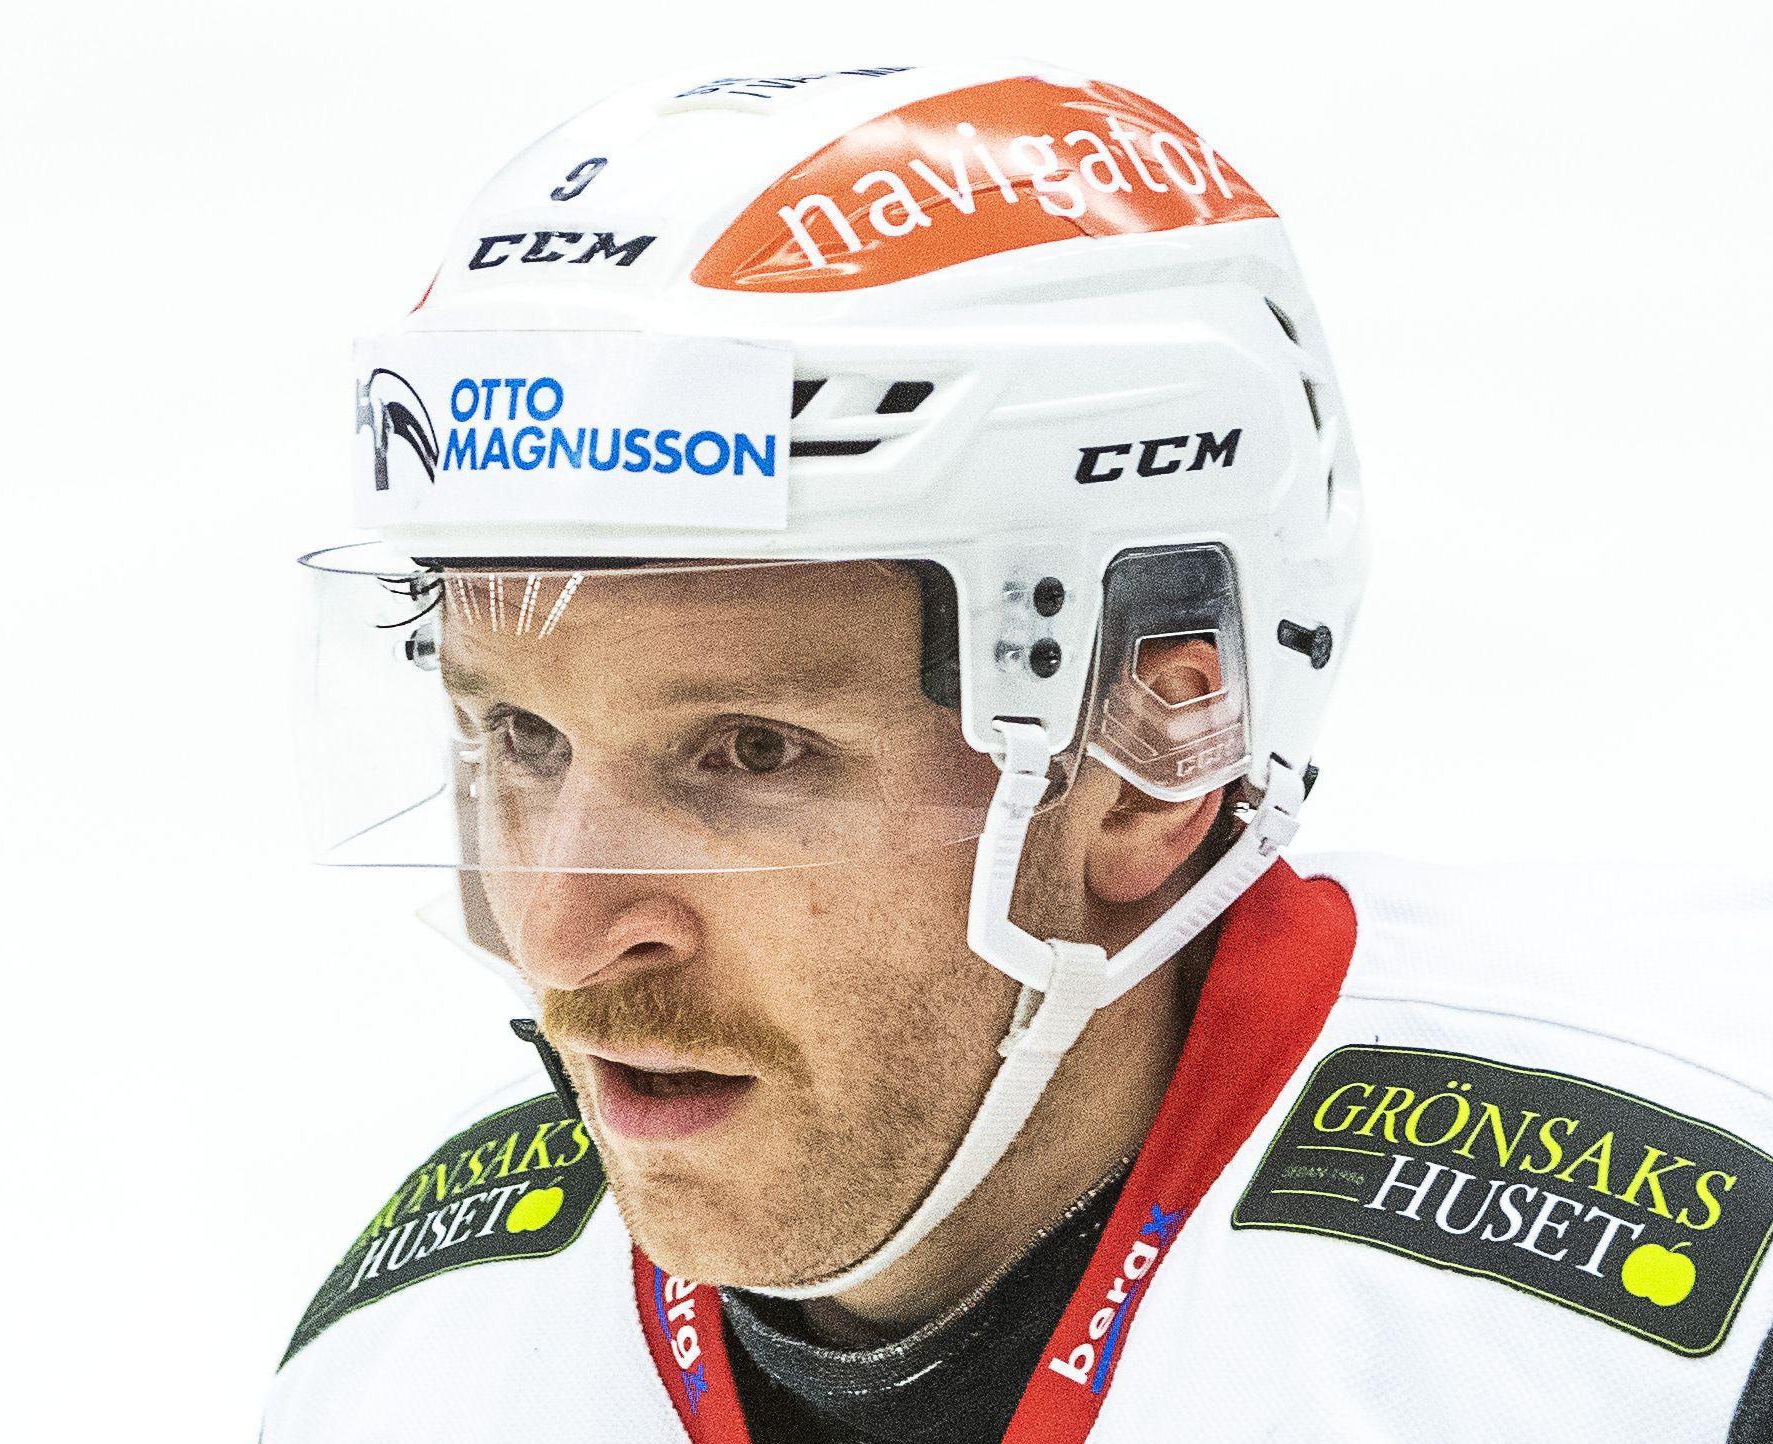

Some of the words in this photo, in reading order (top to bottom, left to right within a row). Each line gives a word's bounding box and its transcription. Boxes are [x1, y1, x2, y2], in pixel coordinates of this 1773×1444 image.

[550, 157, 608, 202] 9
[777, 112, 1234, 272] navigator
[467, 230, 657, 271] CCM
[450, 376, 565, 423] OTTO
[442, 425, 777, 478] MAGNUSSON
[1073, 427, 1243, 485] CCM
[1313, 1081, 1737, 1231] GRÖNSAKS
[347, 1181, 530, 1290] HUSET
[1364, 1154, 1646, 1280] HUSET
